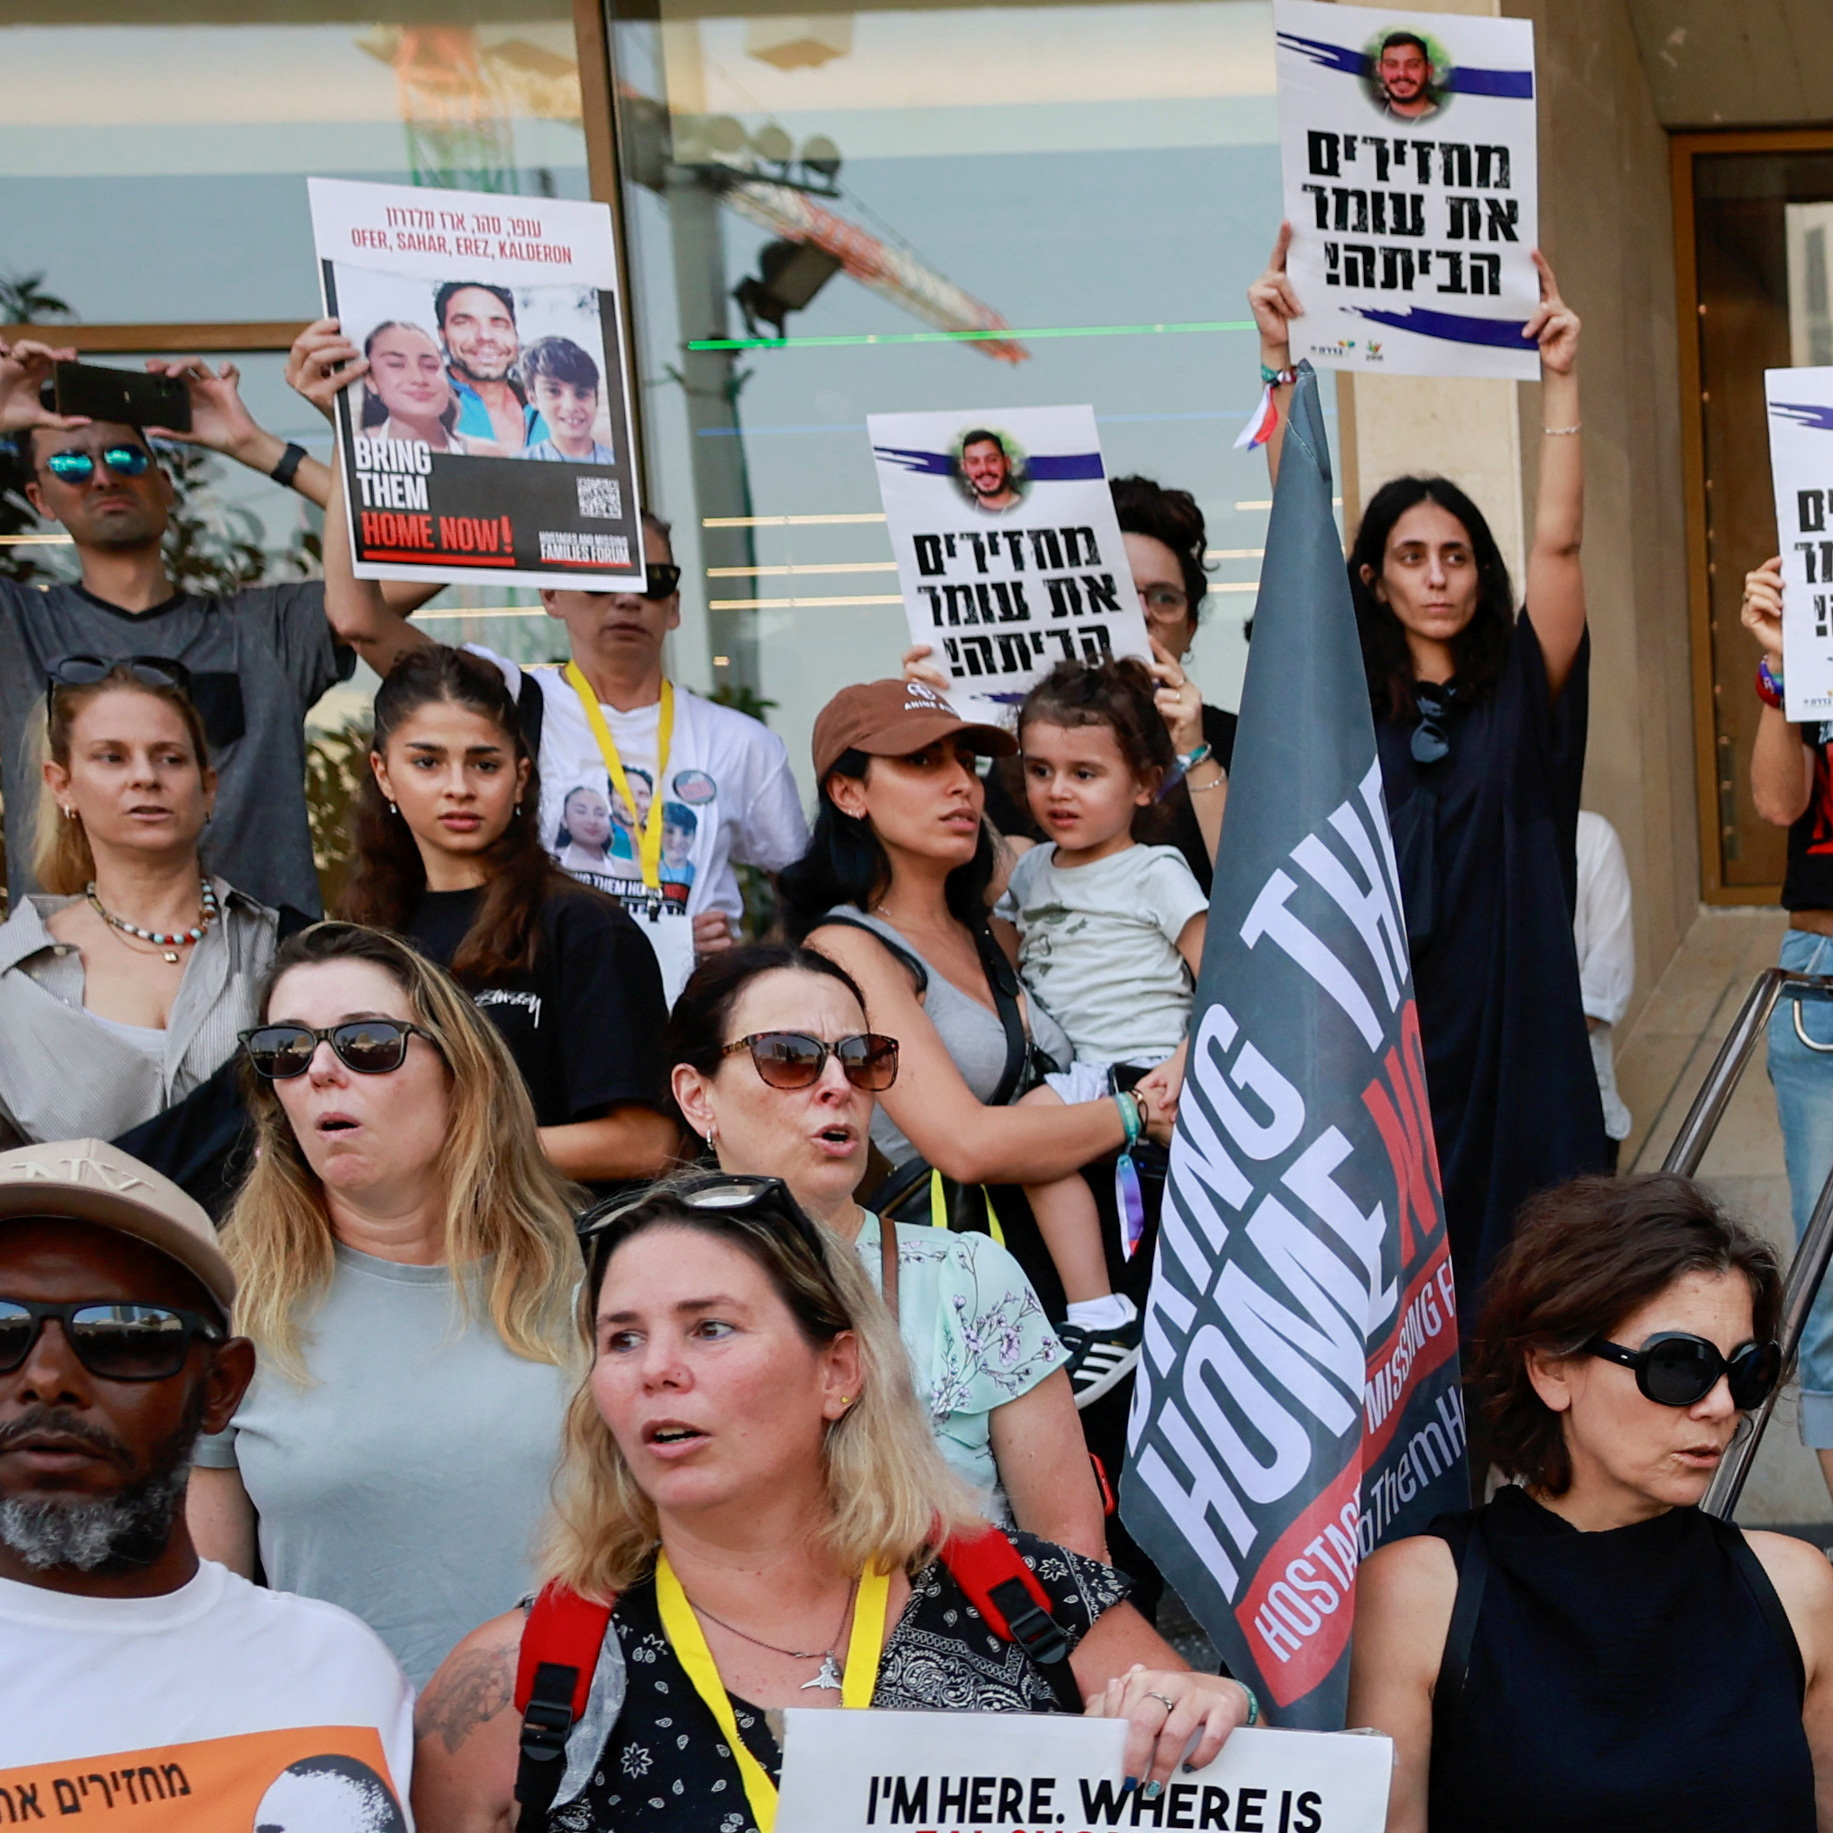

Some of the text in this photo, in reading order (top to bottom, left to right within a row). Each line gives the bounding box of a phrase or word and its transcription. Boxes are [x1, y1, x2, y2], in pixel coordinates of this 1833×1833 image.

[1307, 129, 1511, 189] מחזירים
[440, 210, 466, 231] ארז
[507, 216, 542, 237] עופר,
[1302, 183, 1519, 242] את עומר
[351, 228, 572, 264] OFER, SAHAR, EREZ, KALDERON
[1324, 242, 1501, 295] הביתה!
[353, 436, 433, 475] BRING
[355, 471, 430, 511] THEM
[361, 511, 514, 554] HOME NOW!
[541, 542, 631, 564] FAMILIES FORUM
[913, 526, 1102, 576] מחזירים
[917, 573, 1123, 627] את עומר
[594, 875, 626, 898] THEM
[1136, 1124, 1399, 1604] HOME
[53, 1763, 192, 1815] מחזירים
[866, 1775, 928, 1825] I'M
[938, 1776, 1065, 1825] HERE.
[1078, 1778, 1268, 1833] WHERE
